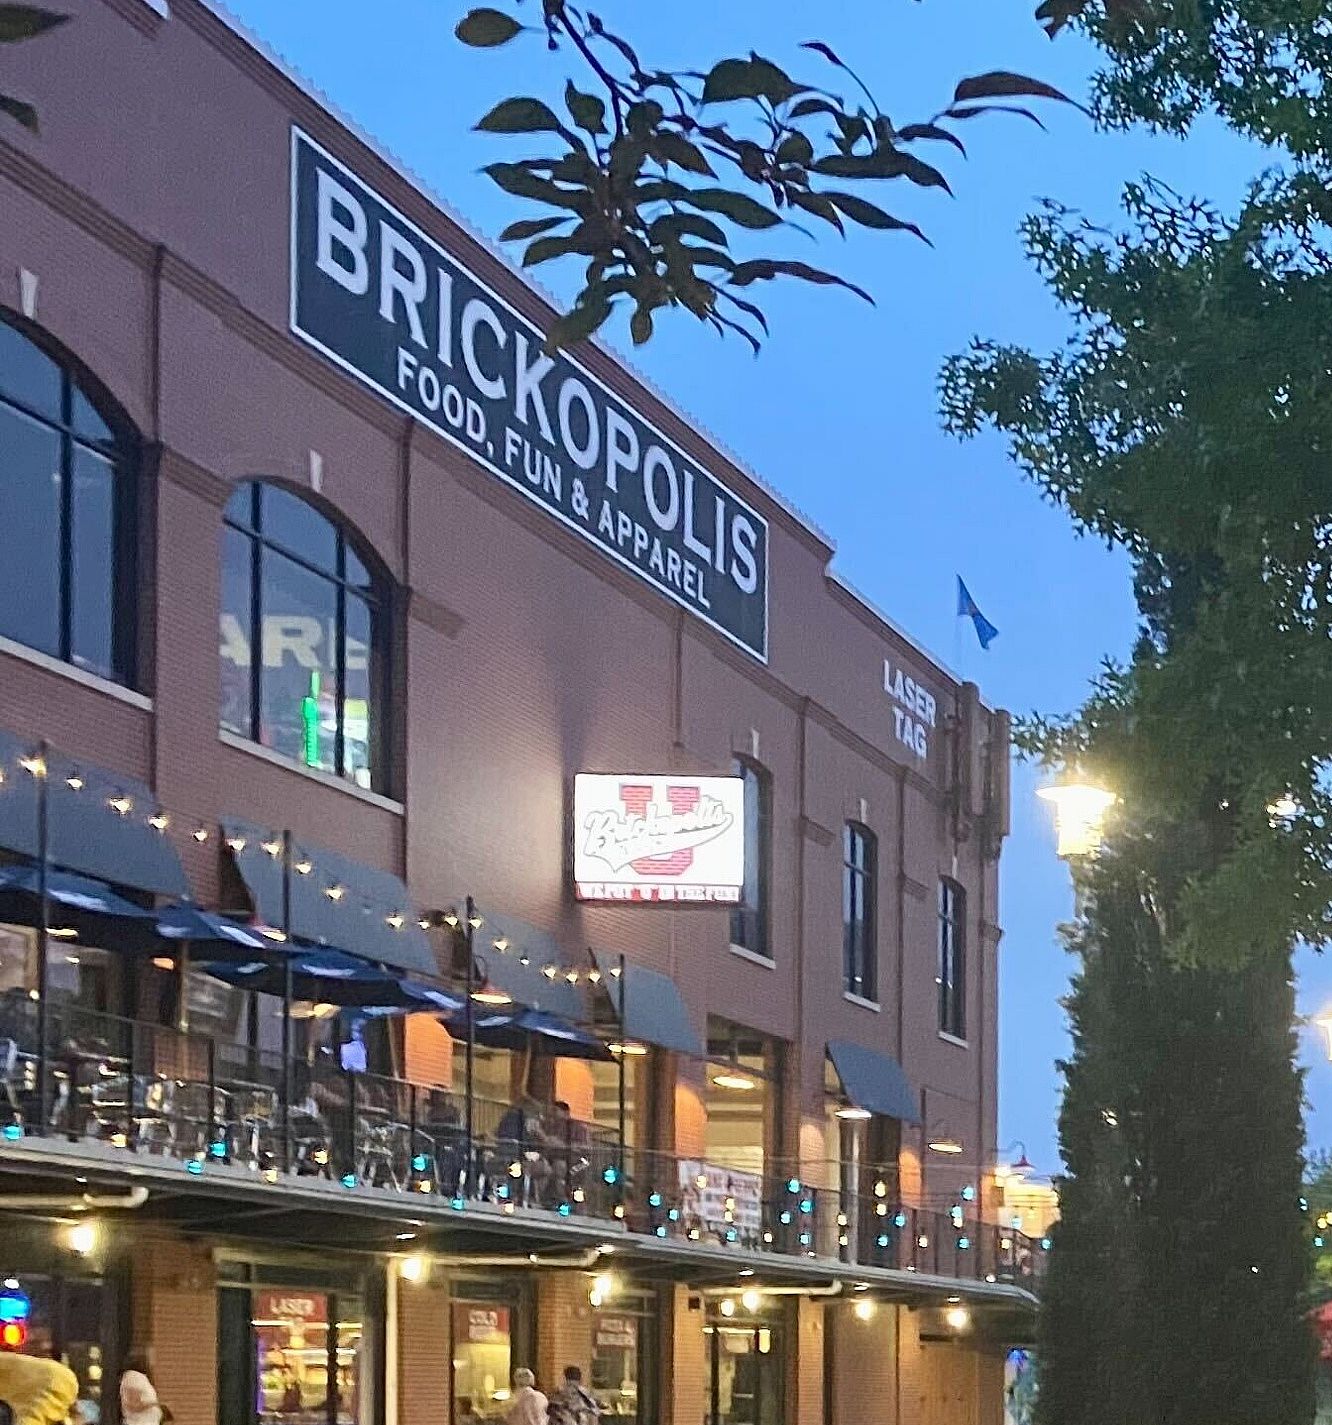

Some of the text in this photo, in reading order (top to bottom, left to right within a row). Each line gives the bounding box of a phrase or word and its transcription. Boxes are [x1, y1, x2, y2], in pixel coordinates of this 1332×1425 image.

[317, 166, 758, 595] BRICKOPOLIS
[398, 346, 711, 609] FOOD, FUN & APPAREL
[883, 659, 937, 728] LASER
[891, 704, 928, 760] TAG
